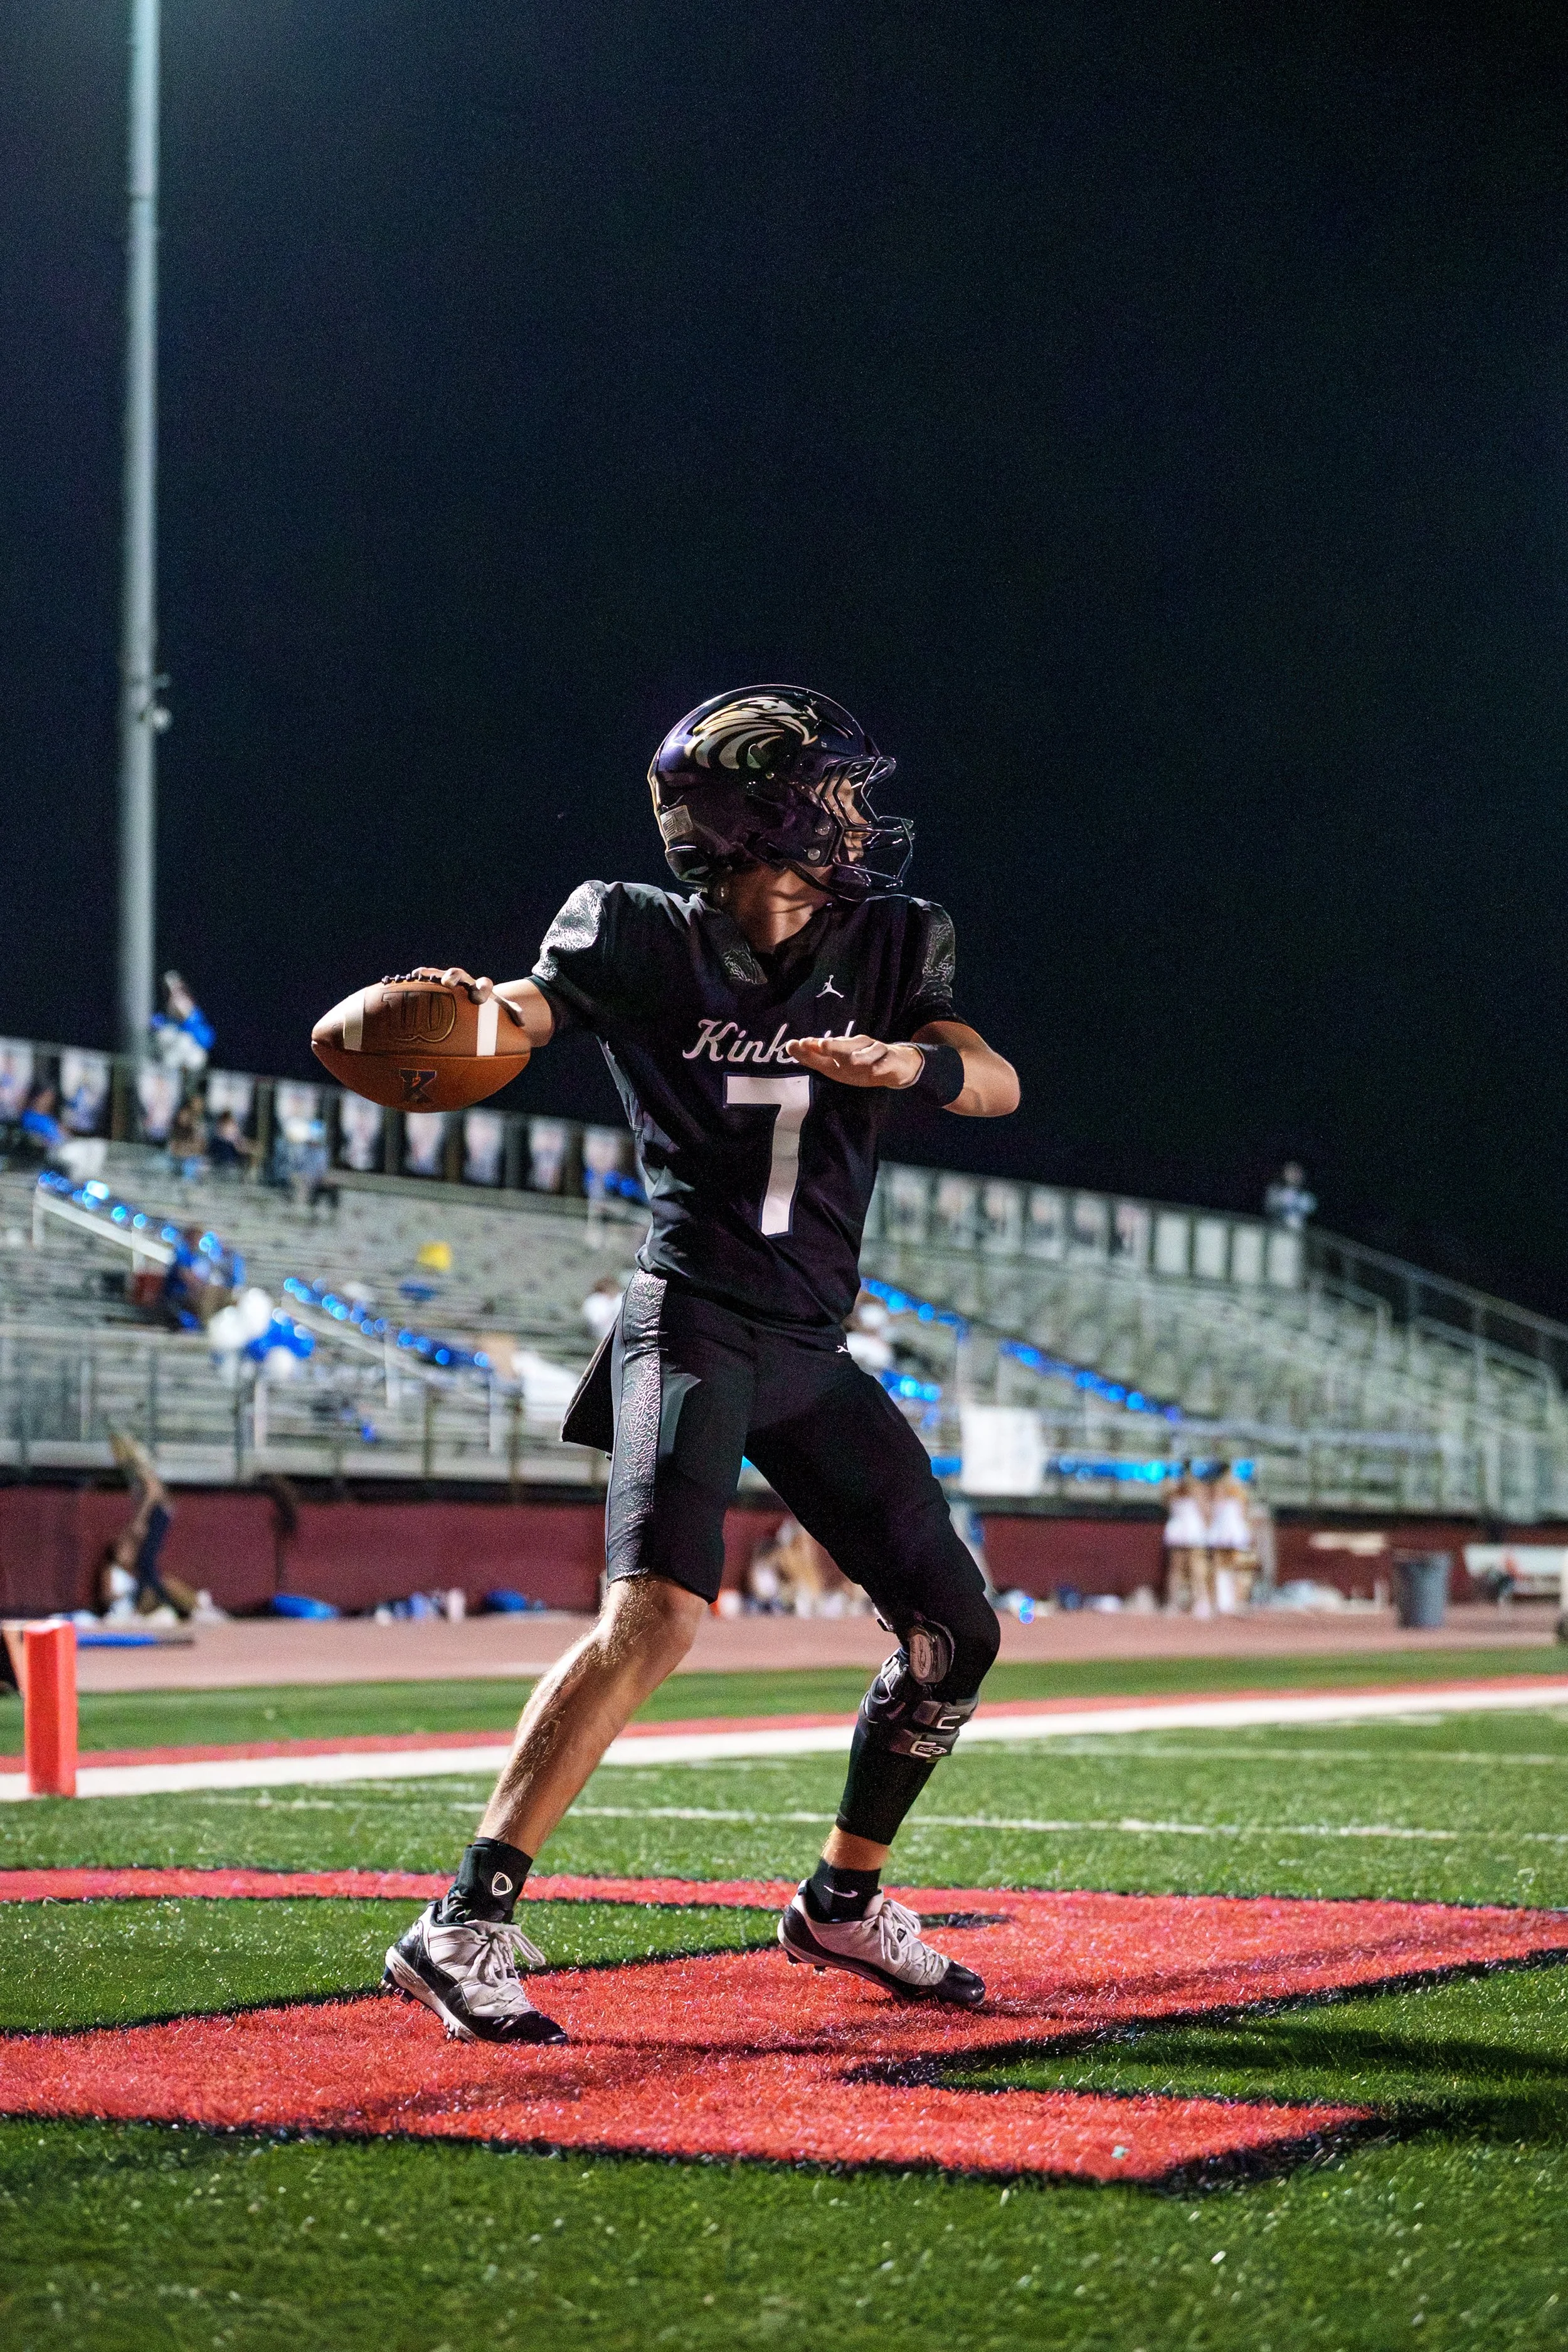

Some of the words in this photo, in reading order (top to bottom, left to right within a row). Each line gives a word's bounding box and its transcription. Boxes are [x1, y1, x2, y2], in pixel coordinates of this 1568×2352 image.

[682, 1019, 856, 1064] Kink
[399, 1067, 437, 1104] K
[723, 1072, 813, 1238] 7
